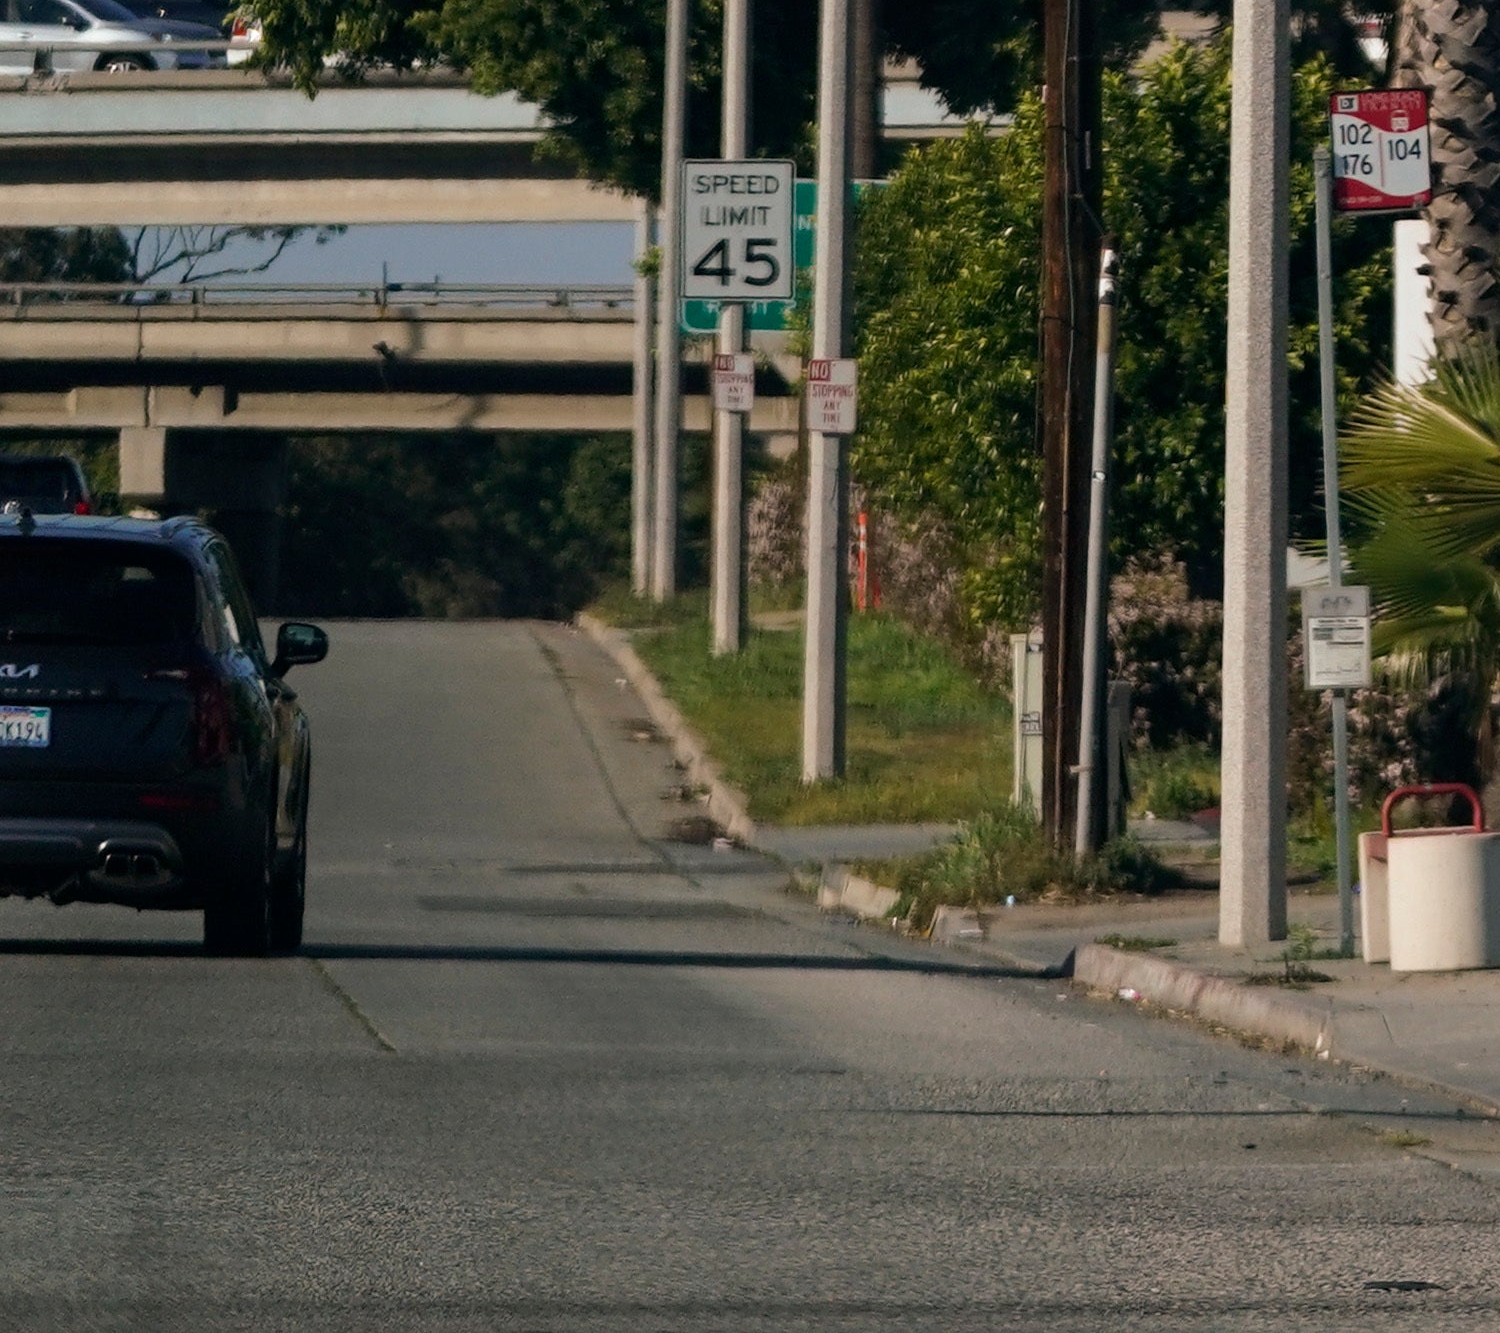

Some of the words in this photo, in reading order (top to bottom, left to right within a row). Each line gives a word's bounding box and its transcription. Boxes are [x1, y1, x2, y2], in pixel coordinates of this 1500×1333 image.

[1339, 124, 1373, 145] 102
[1387, 138, 1422, 161] 104
[1342, 153, 1373, 175] 176
[693, 174, 780, 195] SPEED
[703, 206, 772, 227] LIMIT
[692, 237, 781, 286] 45
[810, 362, 830, 380] NO
